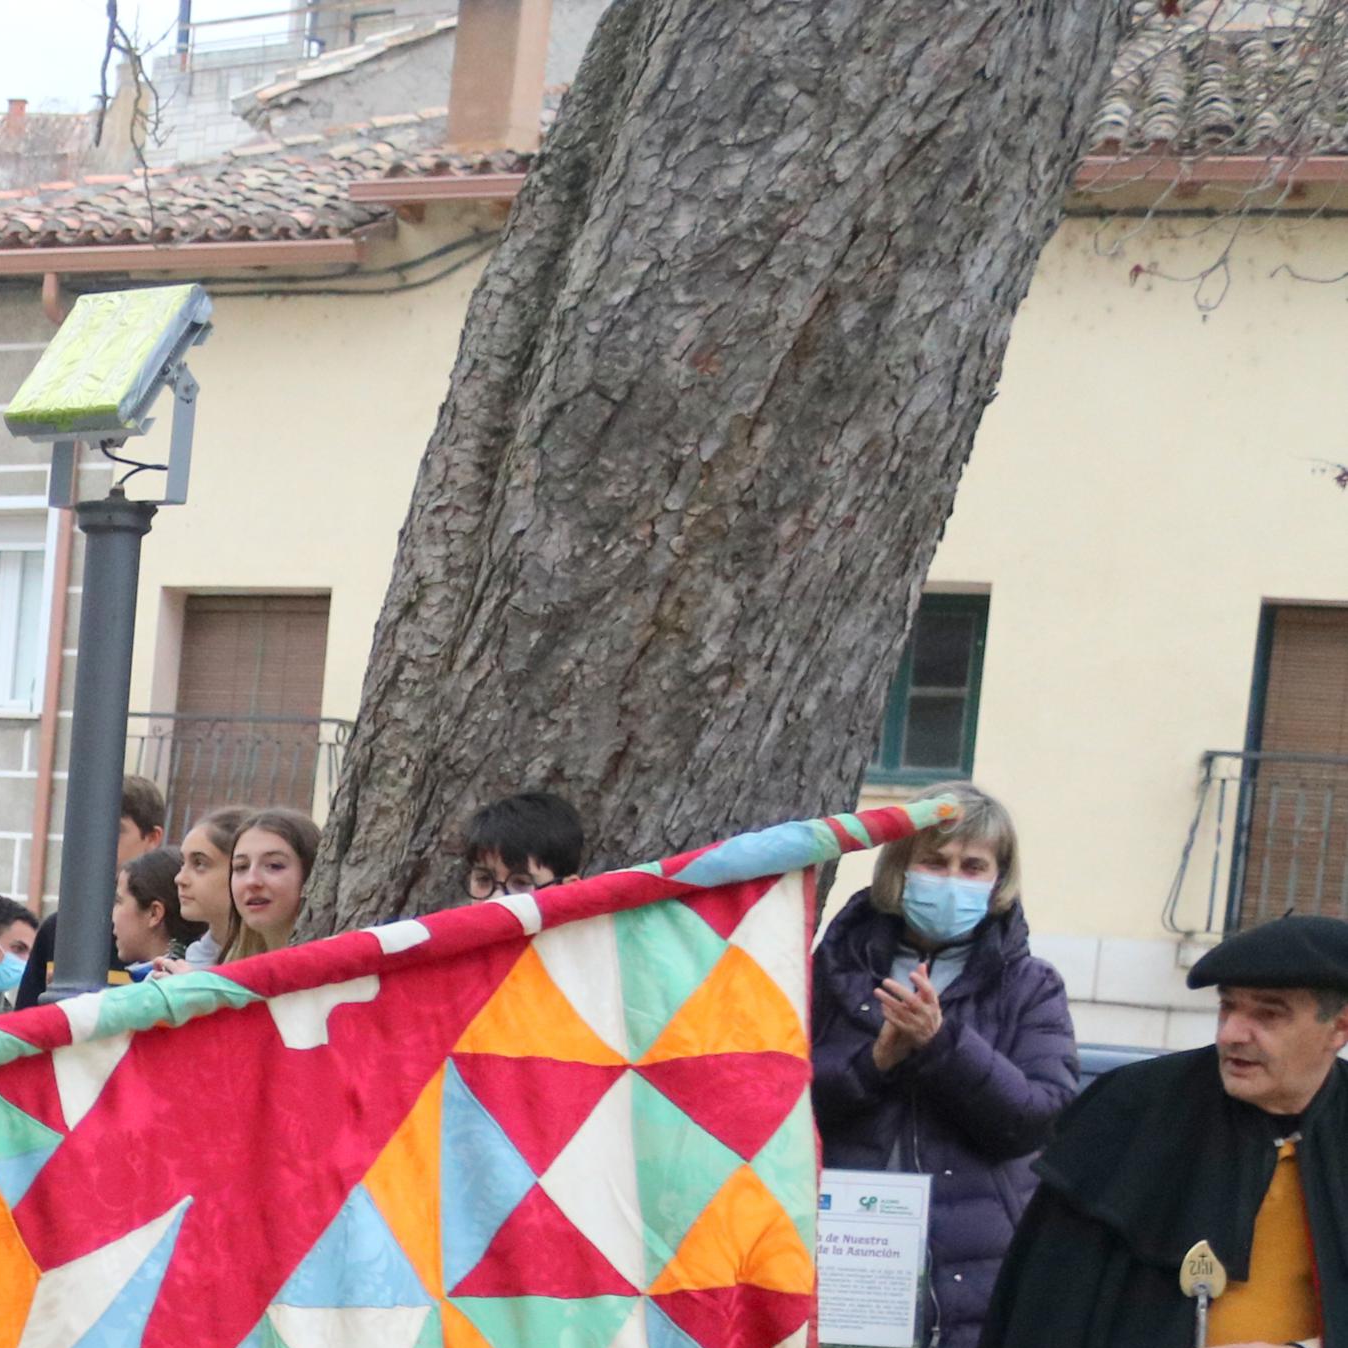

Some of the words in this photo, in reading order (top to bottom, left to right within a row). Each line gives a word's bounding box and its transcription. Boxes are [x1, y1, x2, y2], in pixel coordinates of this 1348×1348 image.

[825, 1233, 839, 1242] de
[842, 1234, 889, 1245] Nuestra
[832, 1245, 843, 1255] la
[846, 1246, 900, 1259] Asunción
